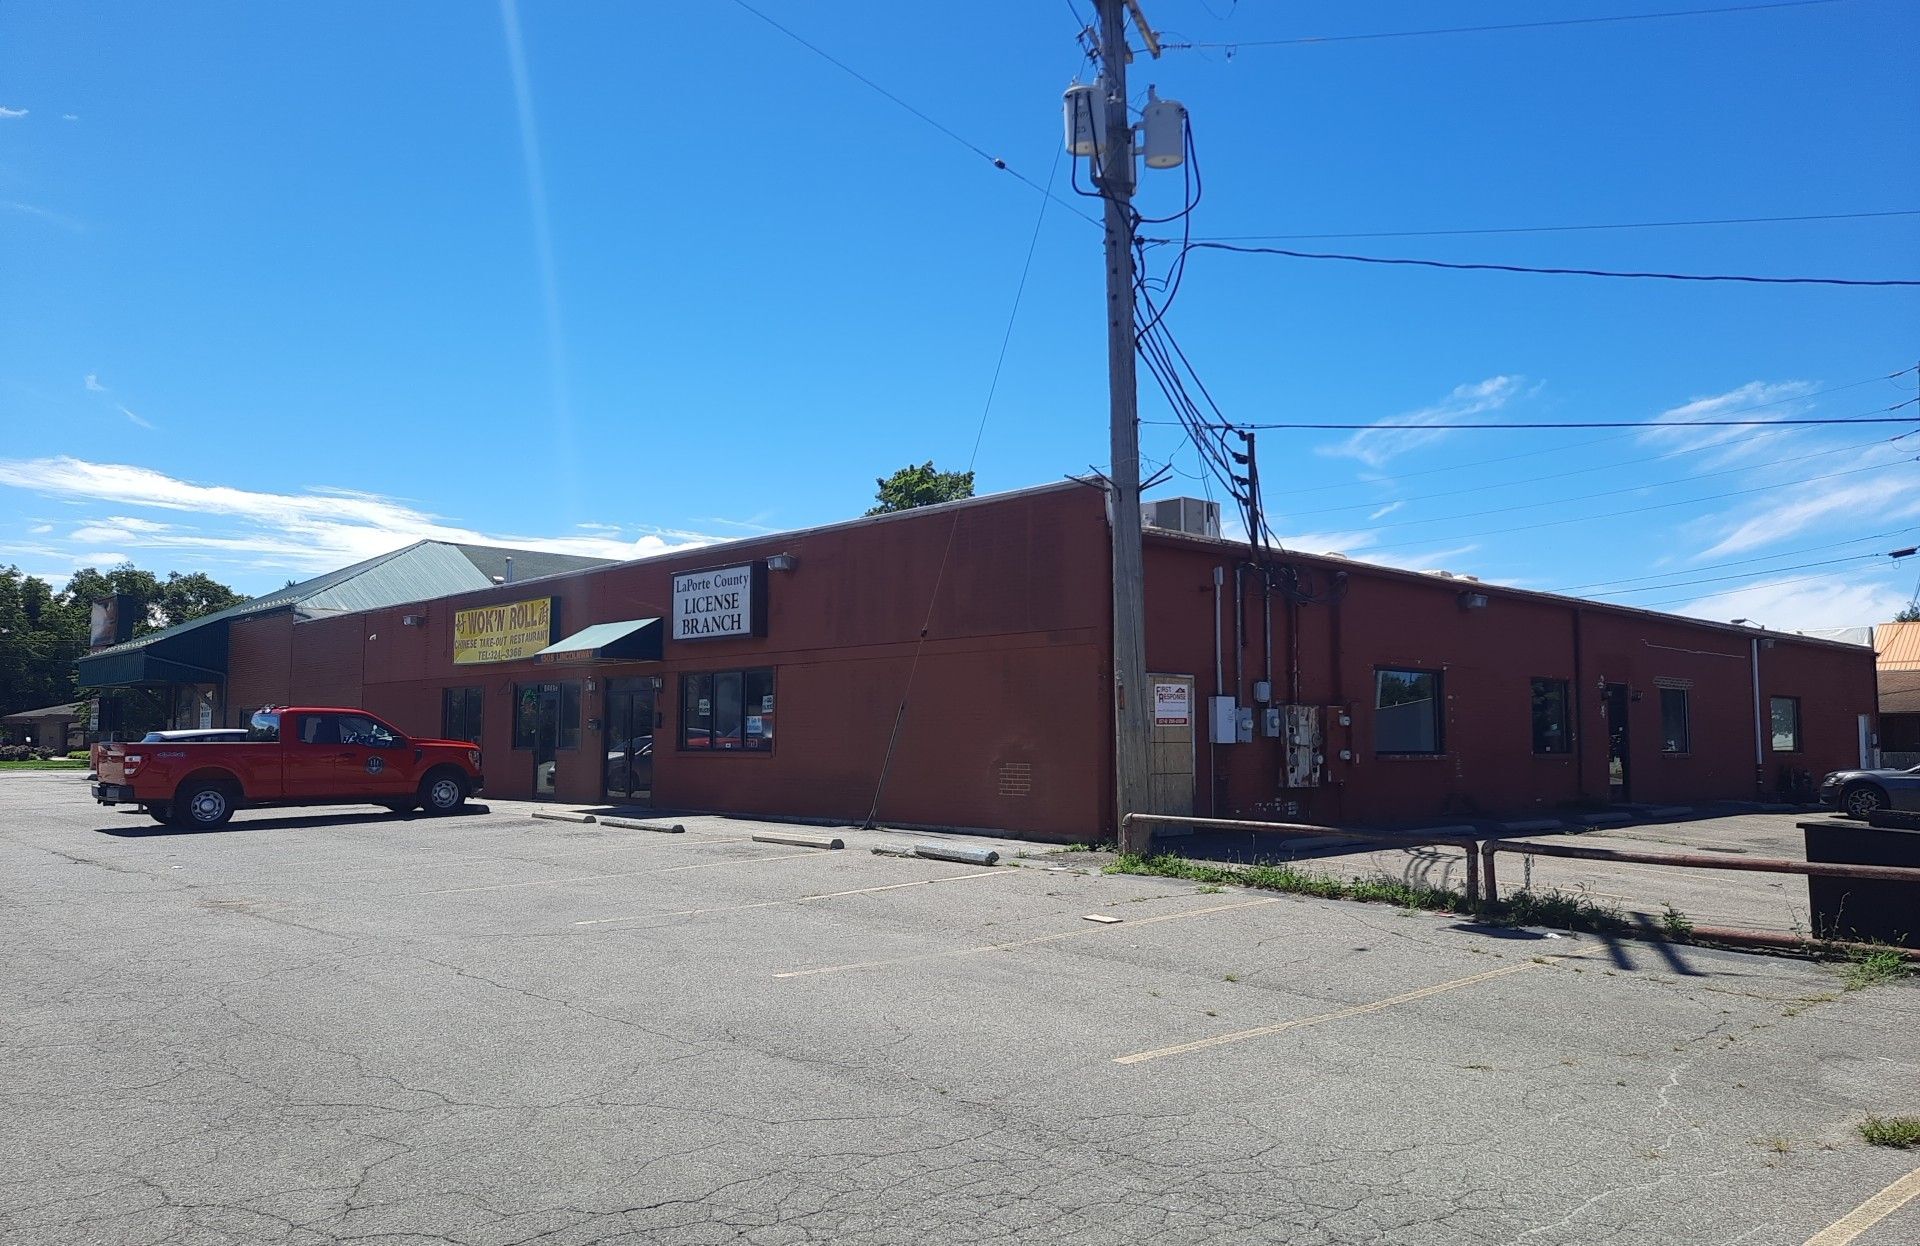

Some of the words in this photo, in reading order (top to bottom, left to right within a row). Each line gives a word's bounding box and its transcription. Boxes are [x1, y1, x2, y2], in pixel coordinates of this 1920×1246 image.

[676, 578, 711, 593] LaPorte
[714, 574, 749, 589] County
[684, 592, 740, 615] LICENSE
[468, 609, 505, 634] WOK'N
[510, 603, 537, 630] ROLL
[682, 613, 742, 635] BRANCH
[455, 639, 478, 650] CHINESE
[479, 635, 508, 648] TAKE-OUT
[509, 629, 549, 646] RESTAURANT
[1156, 687, 1171, 696] FIRST
[1159, 693, 1186, 703] RESPONSE
